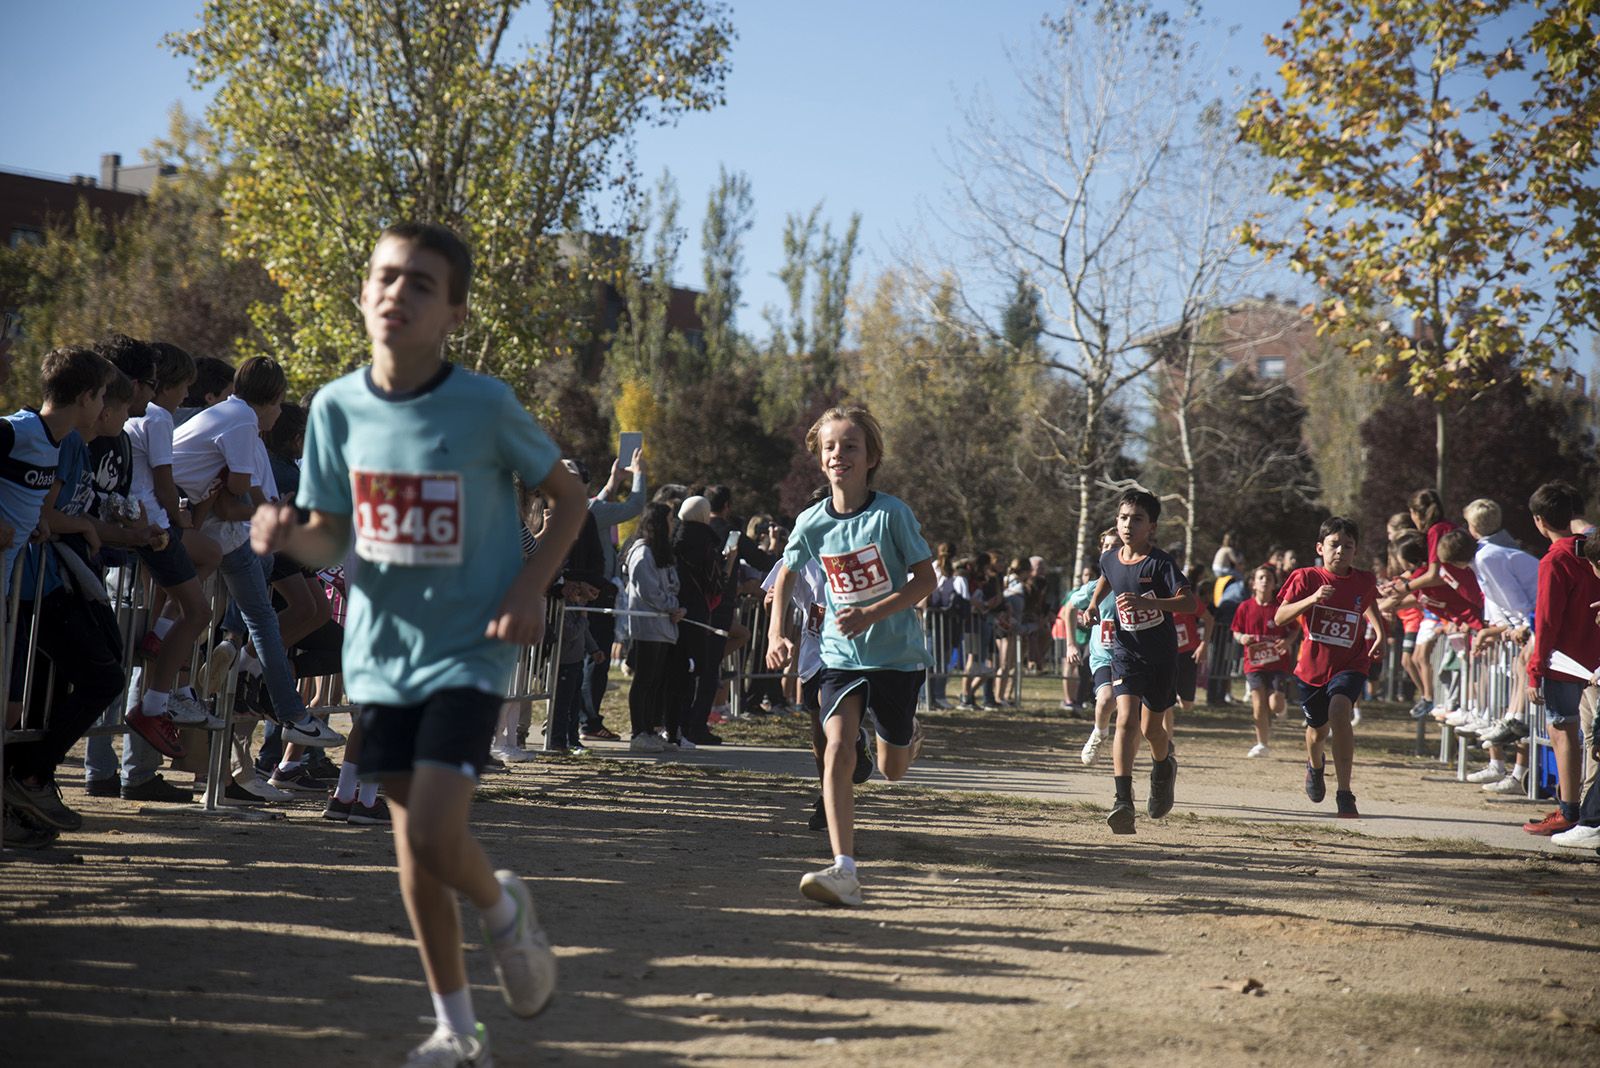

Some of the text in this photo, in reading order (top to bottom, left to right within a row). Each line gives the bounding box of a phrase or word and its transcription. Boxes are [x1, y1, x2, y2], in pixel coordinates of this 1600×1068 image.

[359, 502, 454, 543] 1346
[830, 564, 885, 592] 1351
[1320, 620, 1351, 638] 782
